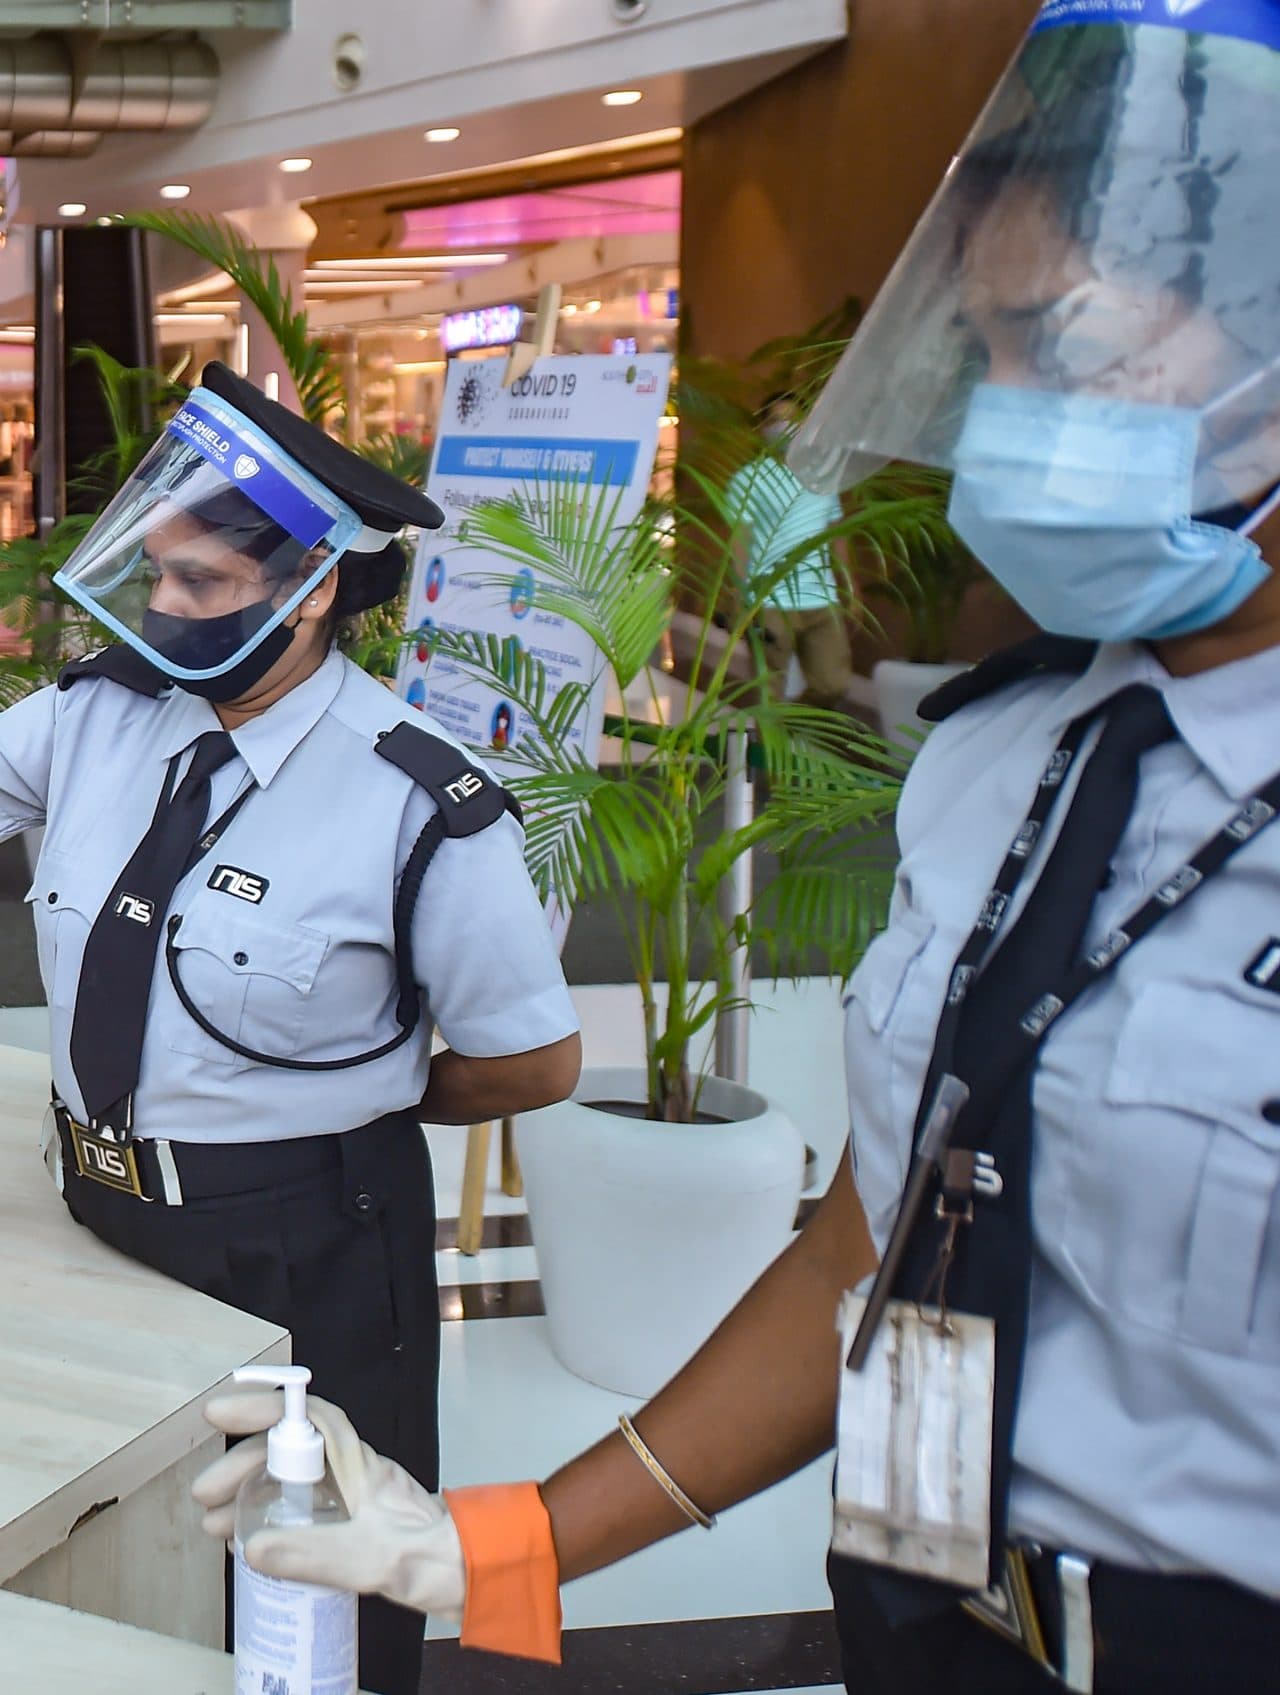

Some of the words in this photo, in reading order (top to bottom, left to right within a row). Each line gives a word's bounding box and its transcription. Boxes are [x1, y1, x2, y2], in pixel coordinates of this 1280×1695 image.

[511, 374, 558, 398] COVID
[561, 373, 577, 396] 19
[179, 410, 197, 427] ACE
[192, 420, 231, 453] SHIELD
